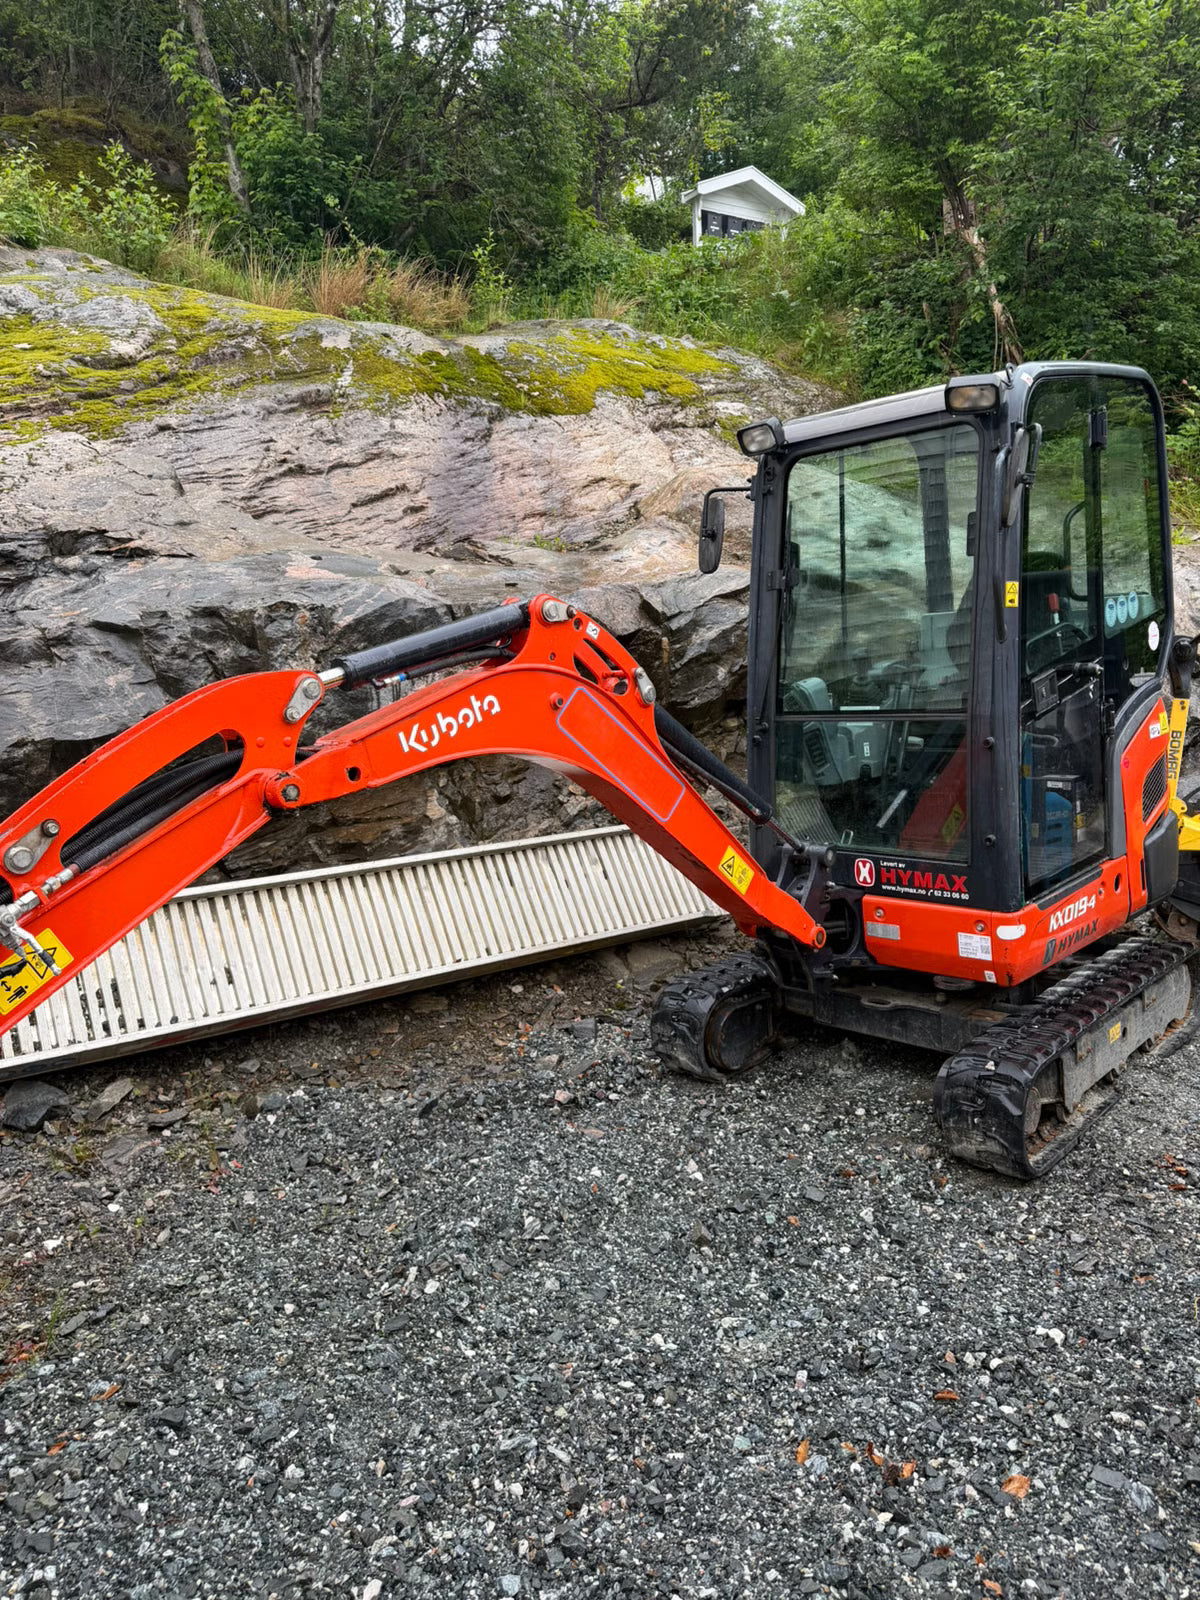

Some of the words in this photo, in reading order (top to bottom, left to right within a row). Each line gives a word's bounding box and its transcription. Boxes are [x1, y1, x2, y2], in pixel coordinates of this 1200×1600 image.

[398, 695, 501, 753] Kubota
[1168, 730, 1182, 779] BOMAG
[880, 867, 968, 893] HYMAX
[882, 884, 926, 895] www.hymax.no
[1057, 917, 1099, 954] HYMAX
